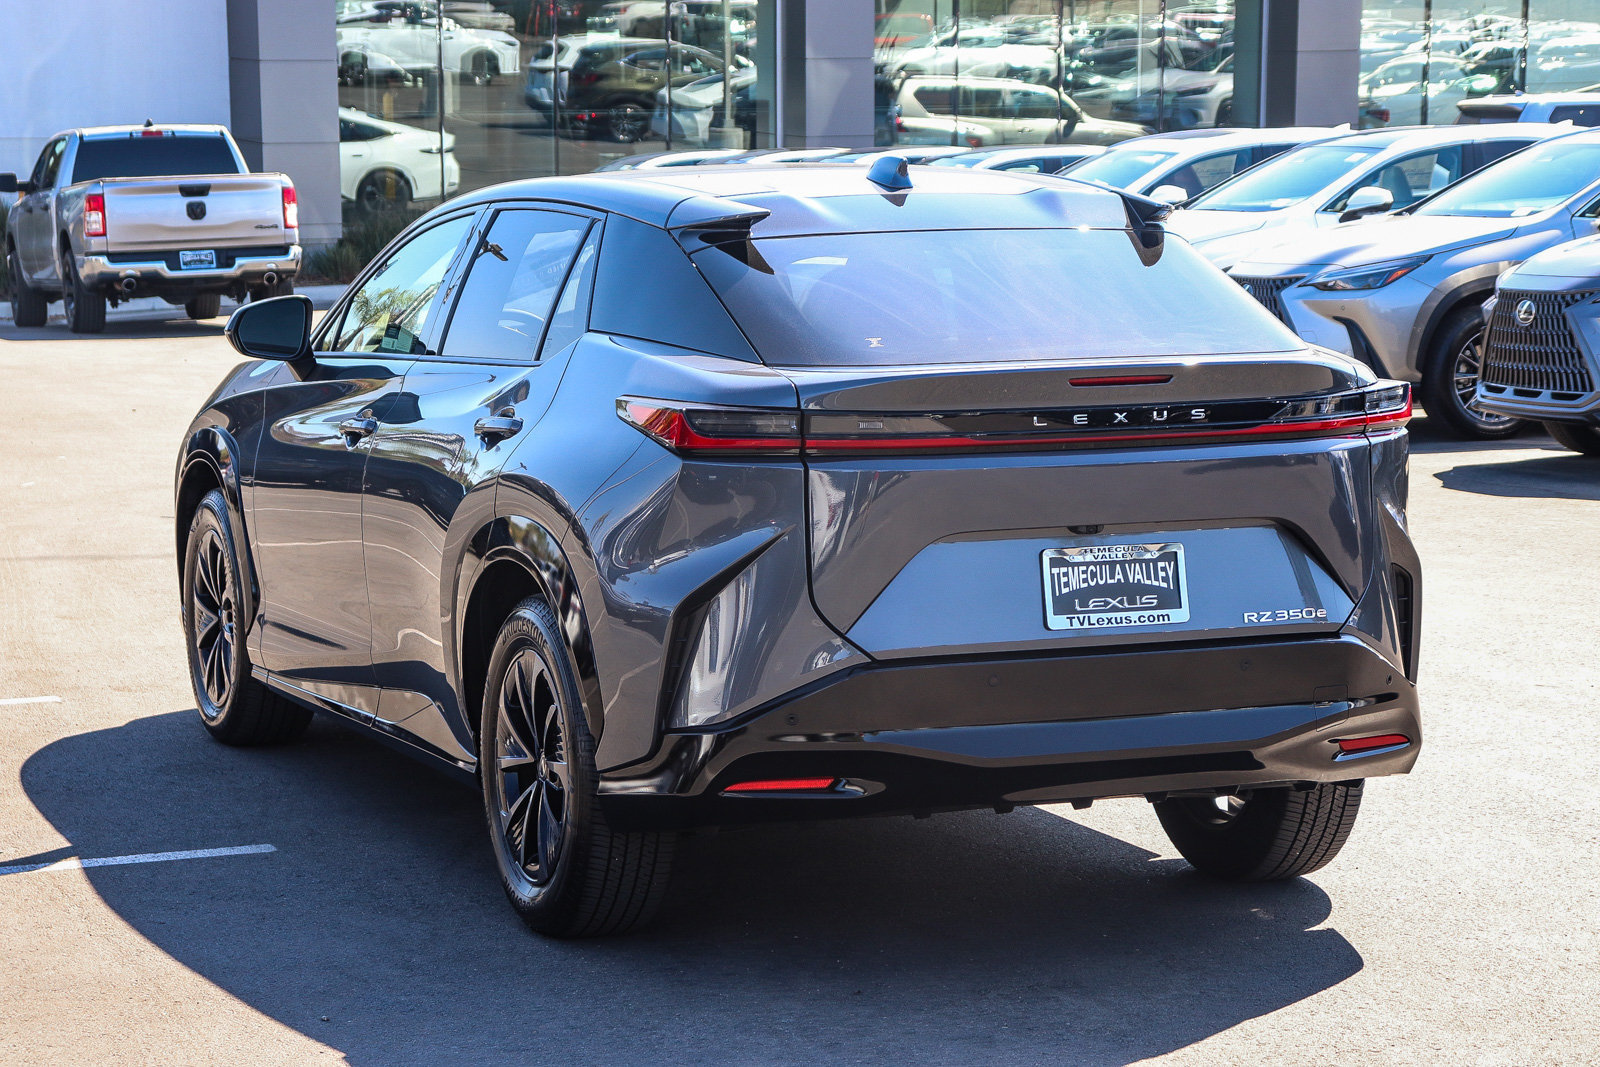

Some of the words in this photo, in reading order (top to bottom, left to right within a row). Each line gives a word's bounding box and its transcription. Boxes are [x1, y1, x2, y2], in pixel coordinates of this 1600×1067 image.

[1033, 408, 1206, 426] LEXUS
[1083, 545, 1144, 555] TEMECULA
[1092, 552, 1135, 560] VALLEY
[1051, 563, 1124, 597] TEMECULA
[1125, 561, 1175, 590] VALLEY
[1075, 594, 1158, 611] LEXUS
[1066, 612, 1171, 627] TVLexus.com
